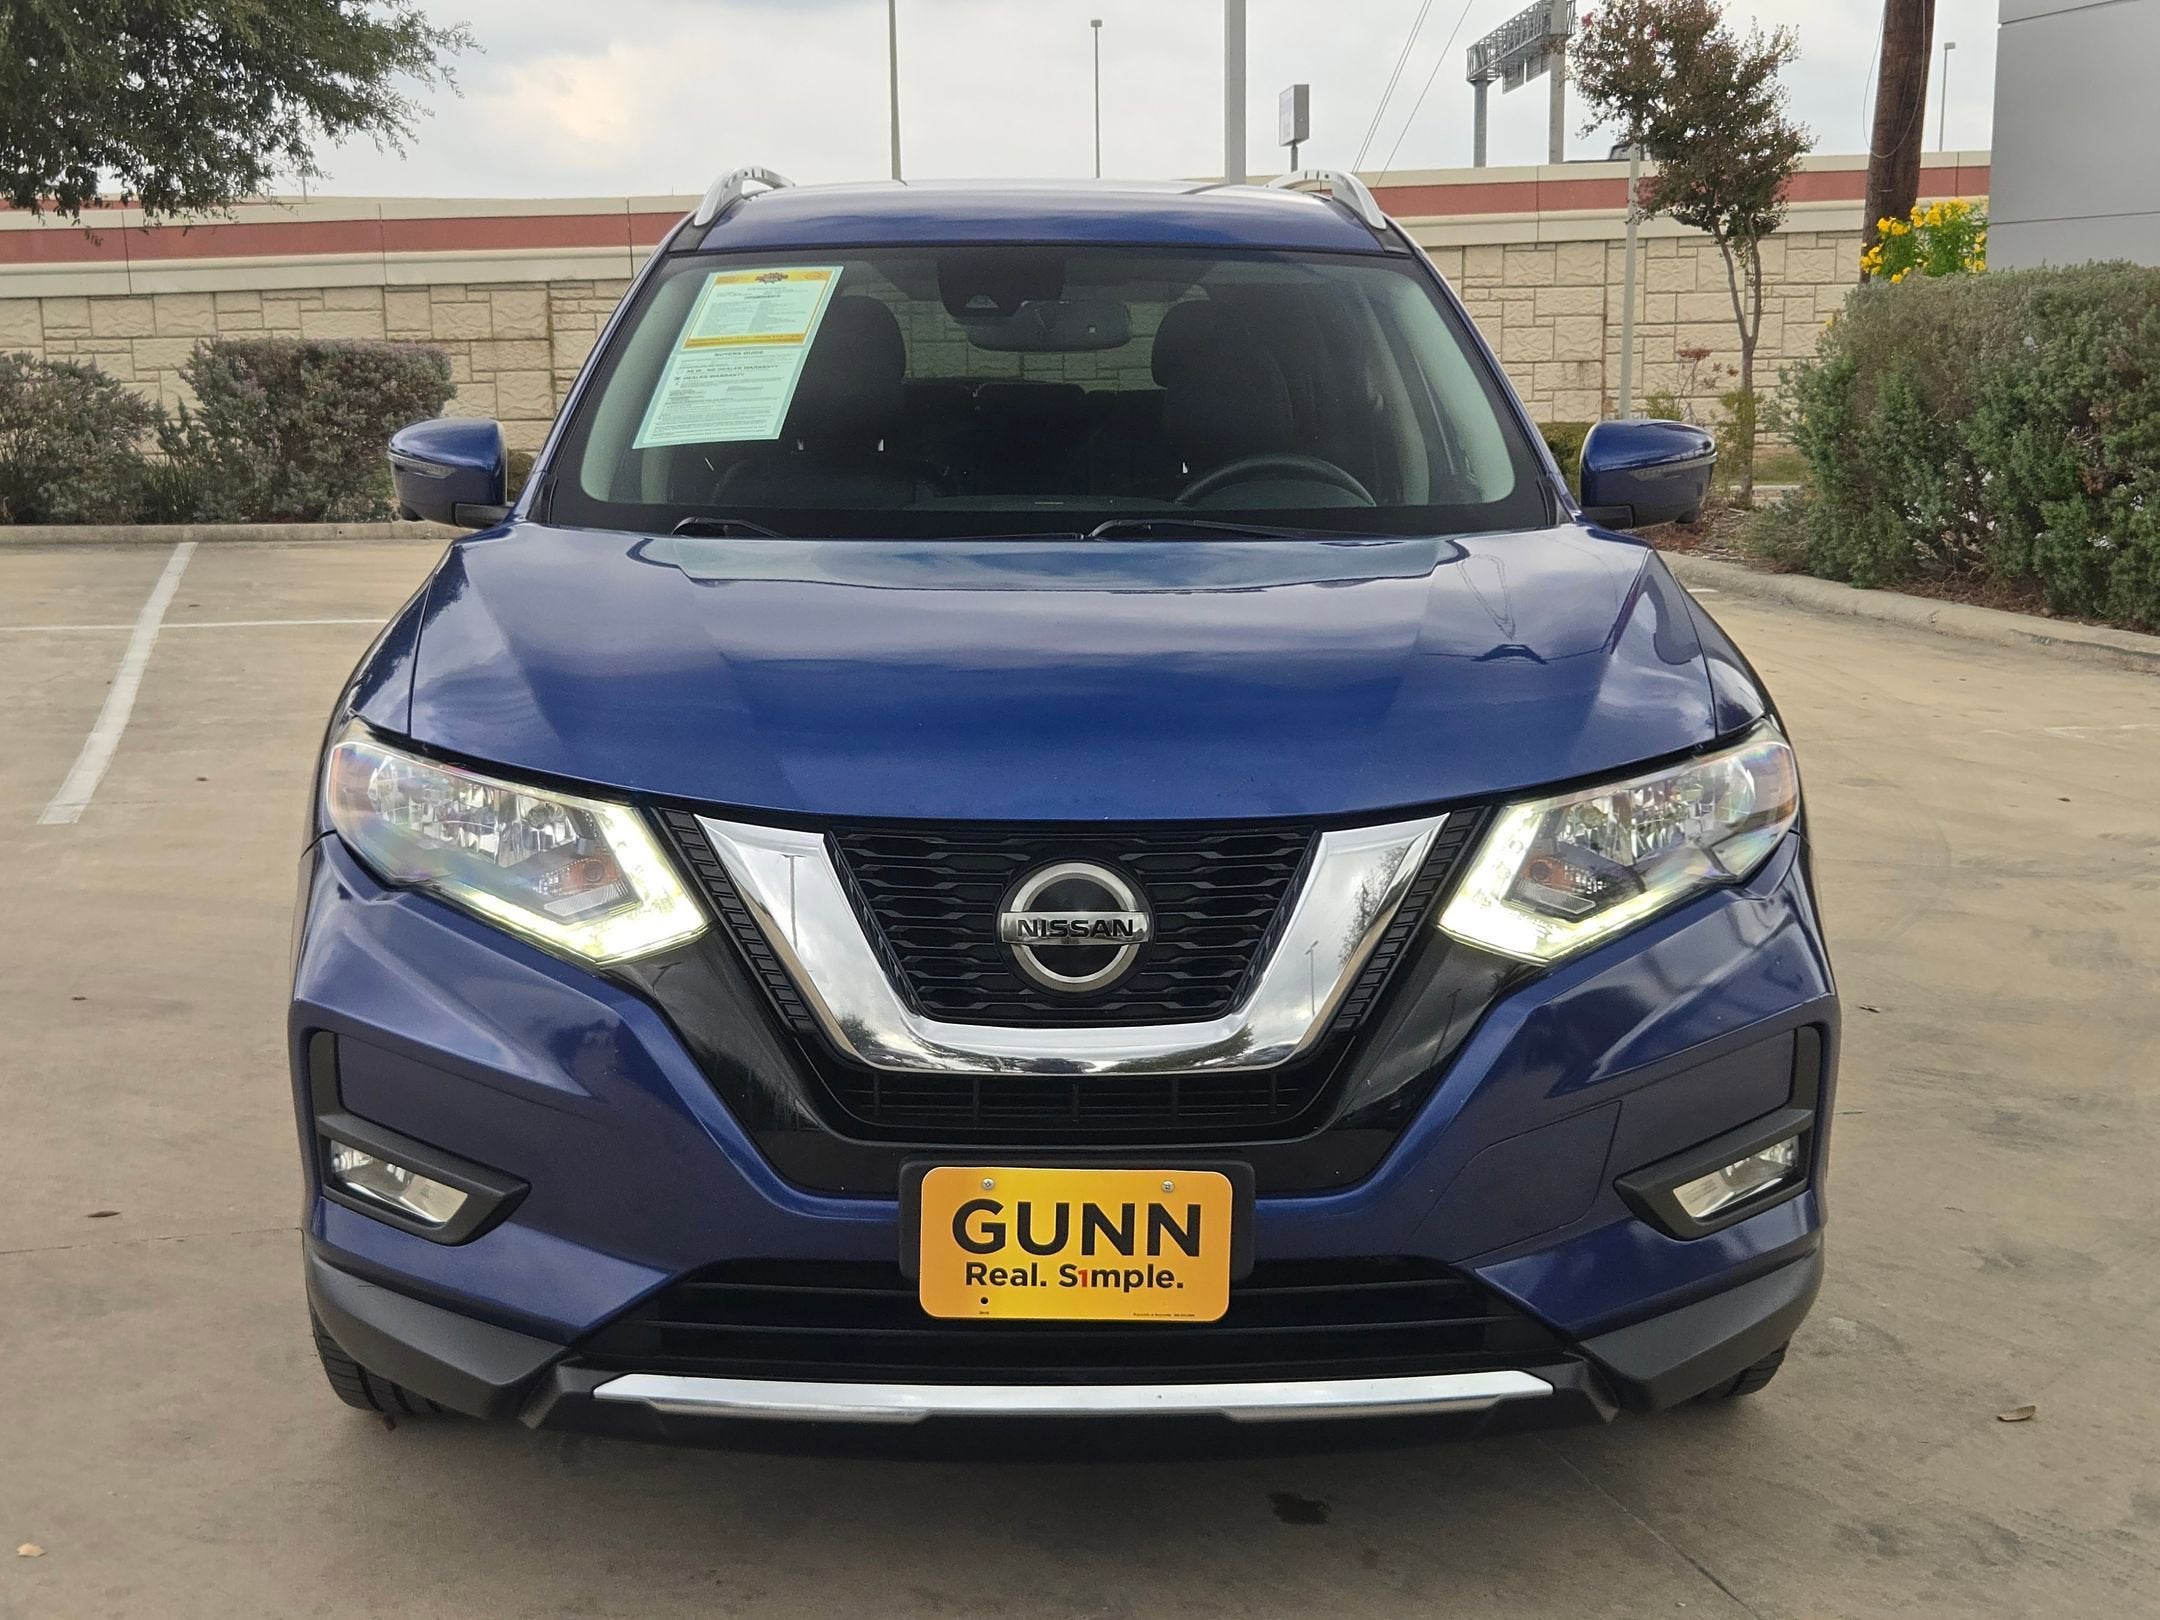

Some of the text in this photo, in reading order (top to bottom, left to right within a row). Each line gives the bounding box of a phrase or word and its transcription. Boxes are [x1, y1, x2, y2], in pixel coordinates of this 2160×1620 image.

[1017, 919, 1134, 938] NISSAN
[952, 1198, 1202, 1257] GUNN
[965, 1261, 1047, 1288] Real.
